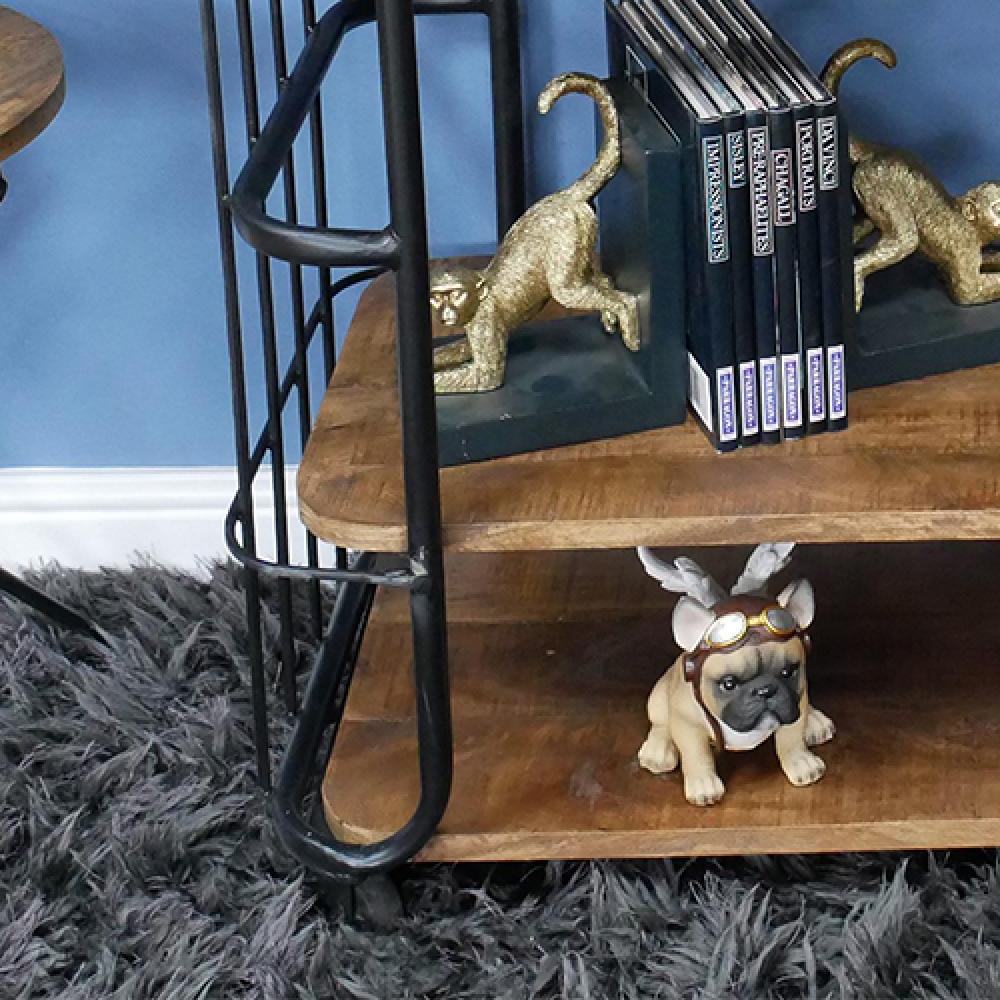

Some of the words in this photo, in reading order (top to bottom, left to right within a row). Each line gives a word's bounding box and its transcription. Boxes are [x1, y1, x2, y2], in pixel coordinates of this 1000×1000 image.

[708, 143, 726, 260] IMPRESSIONISTS
[773, 154, 792, 222] CHAGALL
[801, 126, 815, 207] PORTRAITS
